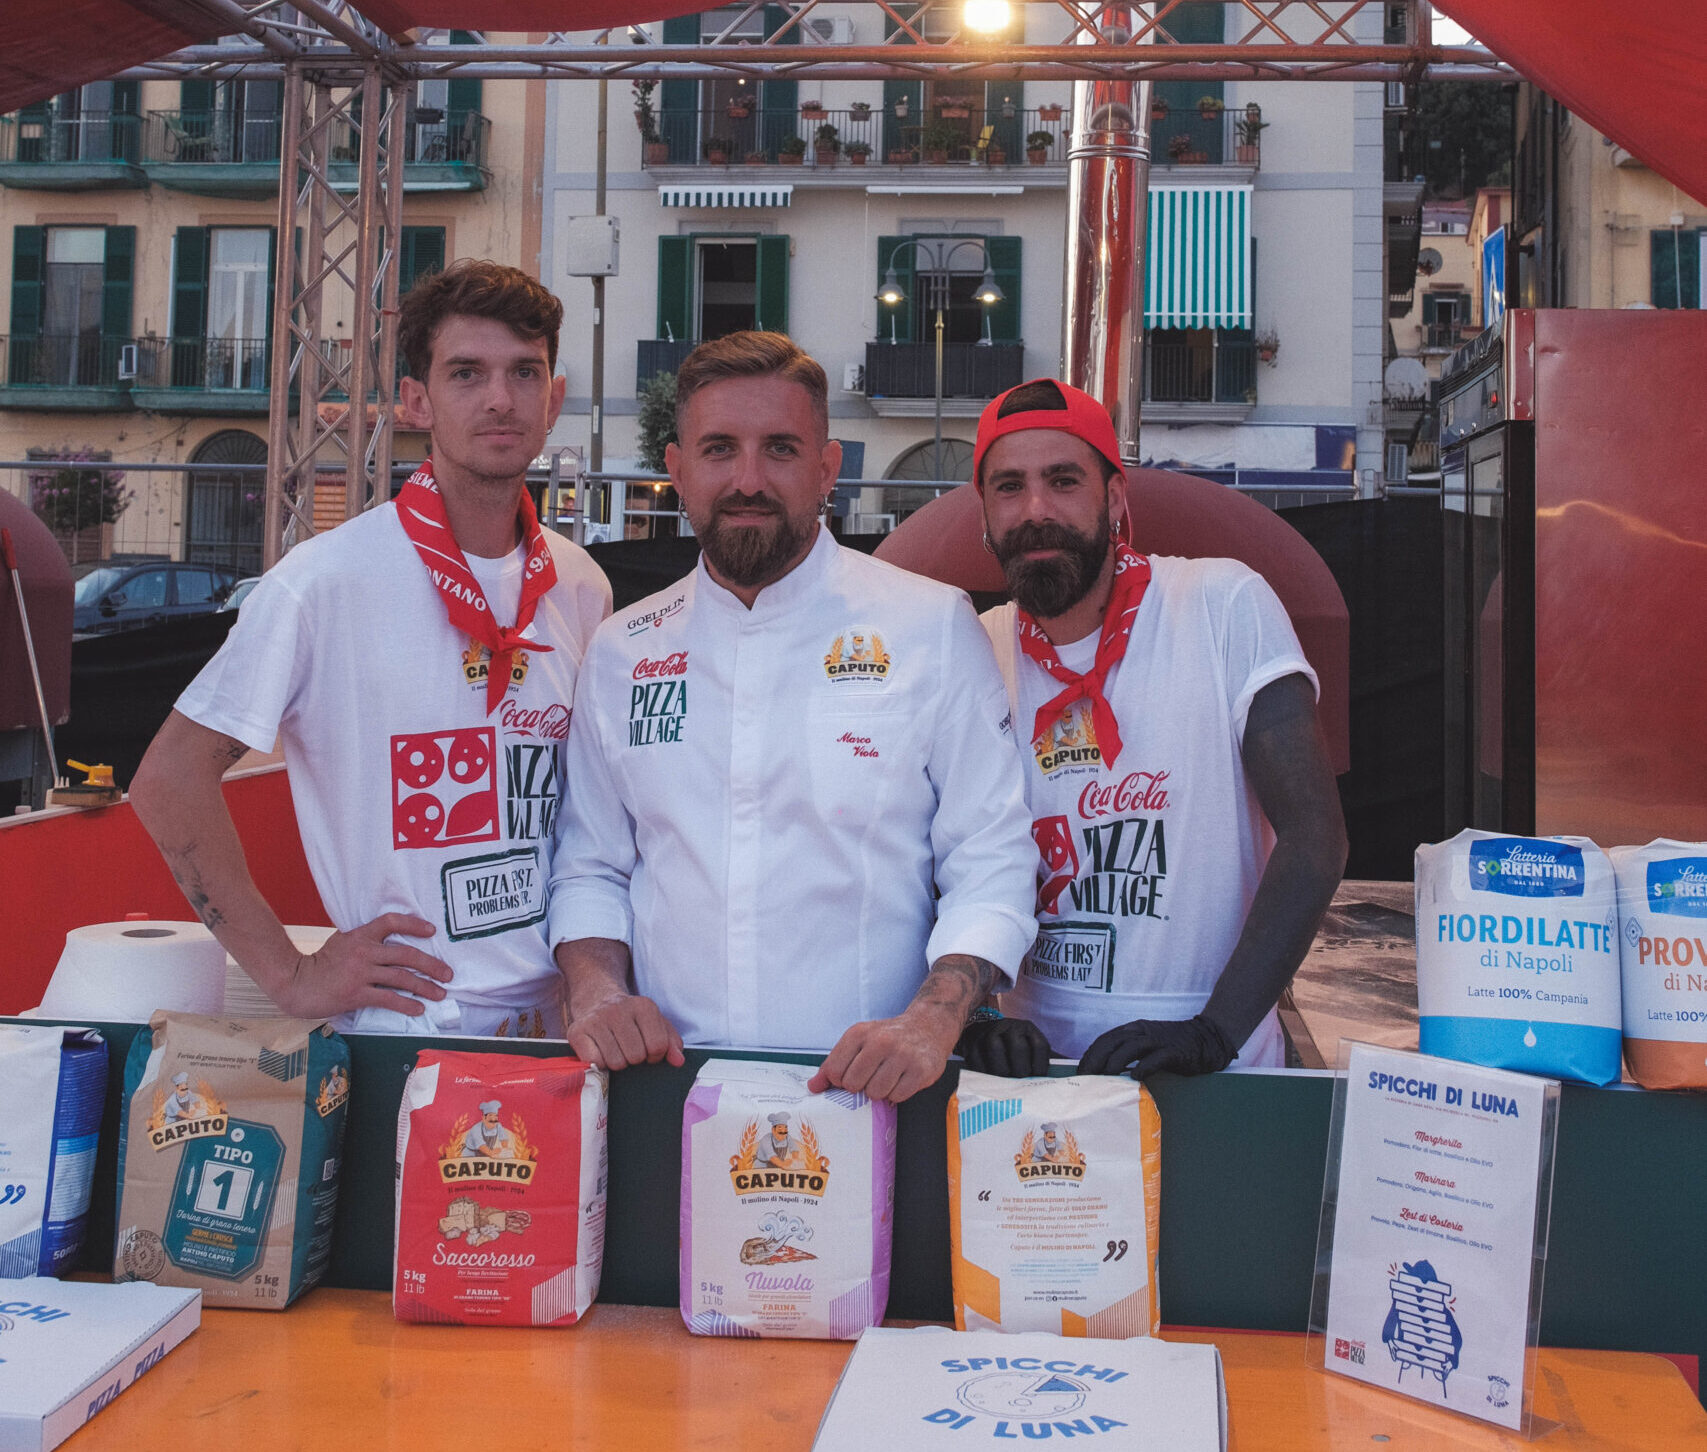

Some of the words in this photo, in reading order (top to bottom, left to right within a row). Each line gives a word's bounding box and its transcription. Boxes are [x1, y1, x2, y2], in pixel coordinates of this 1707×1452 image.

[466, 664, 523, 680] CAO
[828, 664, 886, 674] CAPUTO
[630, 680, 686, 720] PIZZA
[629, 716, 685, 747] VILLAGE
[837, 732, 871, 744] Marco
[853, 746, 879, 758] Viola
[1500, 845, 1556, 863] Latteria
[1478, 860, 1577, 881] SORRENTINA
[466, 873, 509, 900] PIZZA
[1654, 883, 1707, 897] SORRE
[469, 894, 519, 917] PROBLEMS
[1438, 914, 1611, 954] FIORDILATTE
[1480, 949, 1499, 967] di
[1505, 951, 1573, 975] Napoli
[1664, 973, 1680, 990] di
[1468, 986, 1494, 998] Latte
[1499, 987, 1532, 1000] 100%
[1536, 990, 1588, 1005] Campania
[1648, 1009, 1673, 1020] Latte
[1368, 1071, 1437, 1101] SPICCHI
[1445, 1086, 1462, 1106] DI
[1472, 1091, 1519, 1118] LUNA
[152, 1118, 225, 1146] CAPUTO
[1415, 1131, 1463, 1149] Margherita
[214, 1145, 253, 1164] TIPO
[442, 1161, 531, 1180] CAPUTO
[1019, 1165, 1083, 1178] CAPUTO
[1415, 1171, 1456, 1188] Marinara
[212, 1170, 235, 1210] 1
[735, 1173, 824, 1191] CAPUTO
[1419, 1213, 1427, 1222] di
[432, 1243, 535, 1268] Saccorosso
[255, 1275, 262, 1284] 5
[264, 1274, 279, 1287] kg
[404, 1270, 410, 1280] 5
[412, 1270, 426, 1283] kg
[745, 1271, 814, 1291] Nuvola
[255, 1288, 265, 1297] 11
[269, 1288, 277, 1298] lb
[404, 1284, 414, 1293] 11
[416, 1284, 424, 1294] lb
[701, 1282, 707, 1291] 5
[709, 1282, 723, 1295] kg
[134, 1342, 165, 1382] PIZZA
[940, 1357, 1129, 1383] SPICCHI
[86, 1378, 121, 1422] PIZZA
[922, 1408, 977, 1430] DI
[994, 1414, 1129, 1440] LUNA
